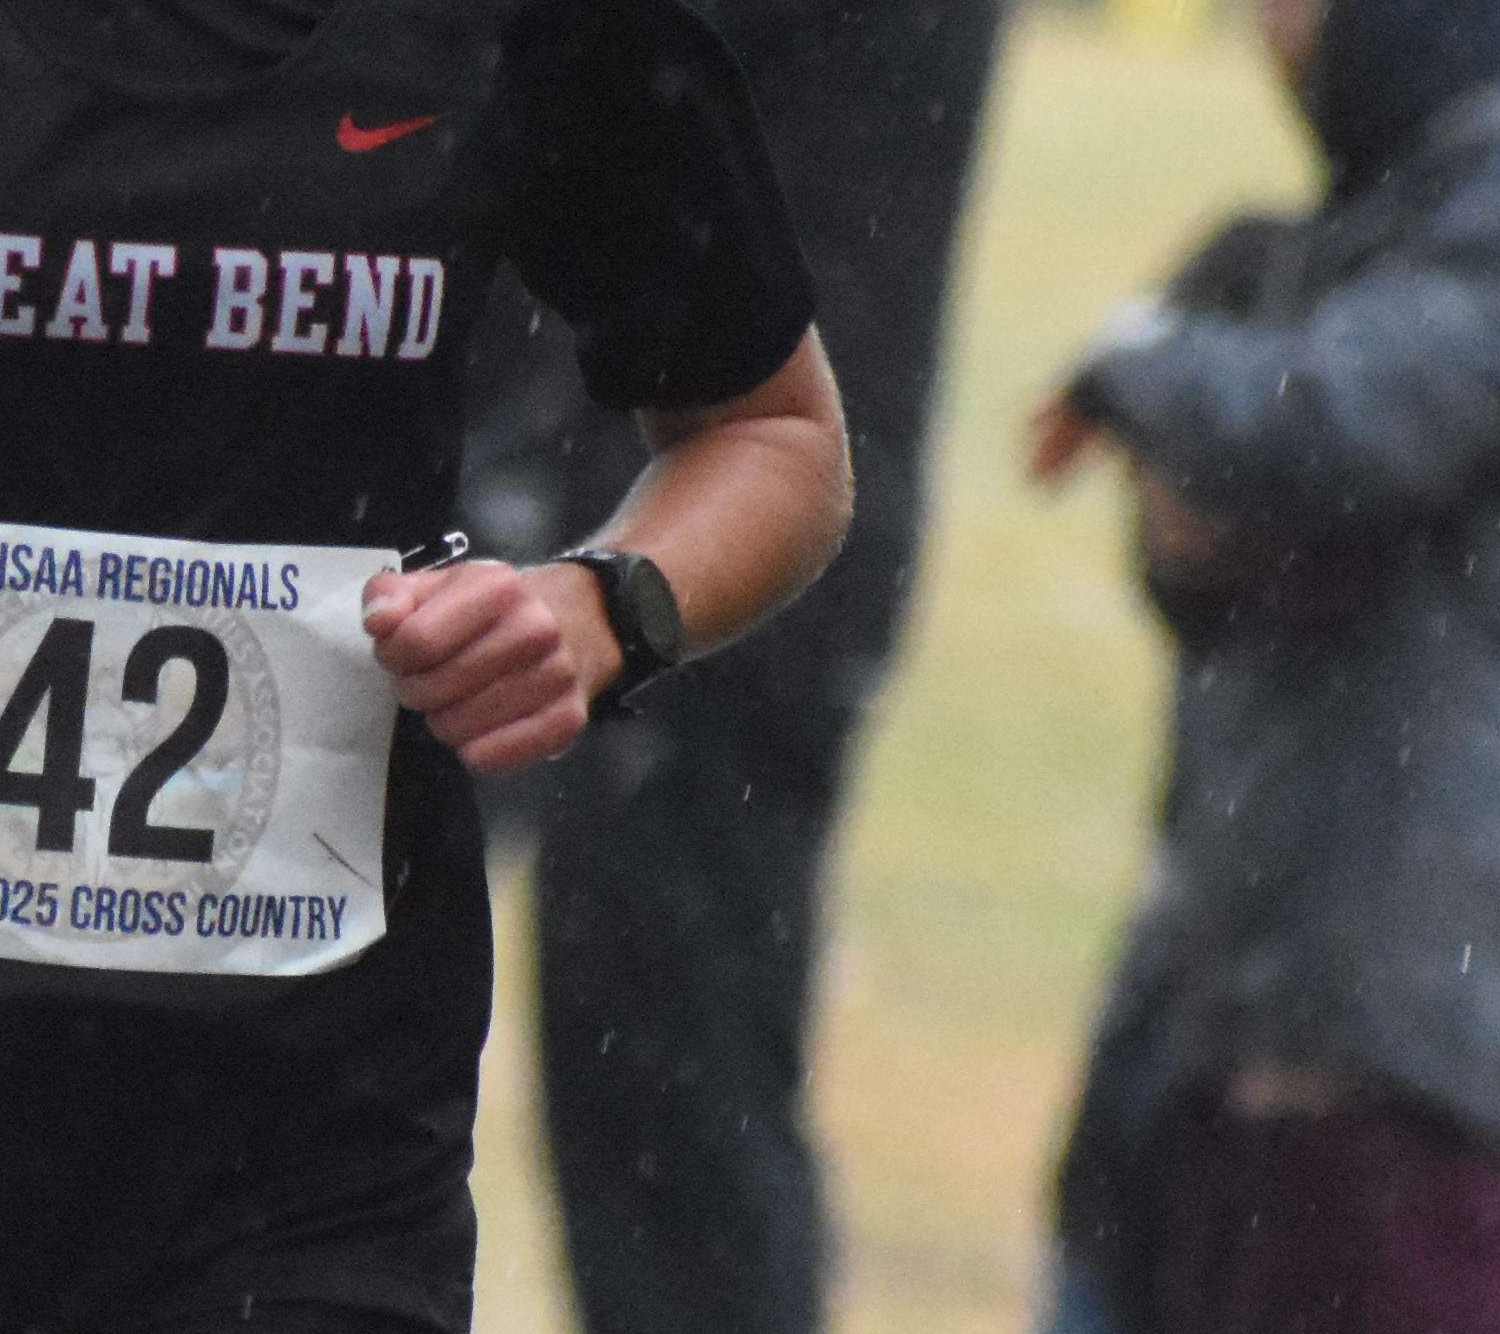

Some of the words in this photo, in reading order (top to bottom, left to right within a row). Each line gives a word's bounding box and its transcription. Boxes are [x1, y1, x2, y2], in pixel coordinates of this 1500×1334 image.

[205, 246, 445, 360] BEND
[97, 550, 300, 612] REGIONALS
[70, 884, 187, 936] CROSS
[197, 893, 348, 941] COUNTRY
